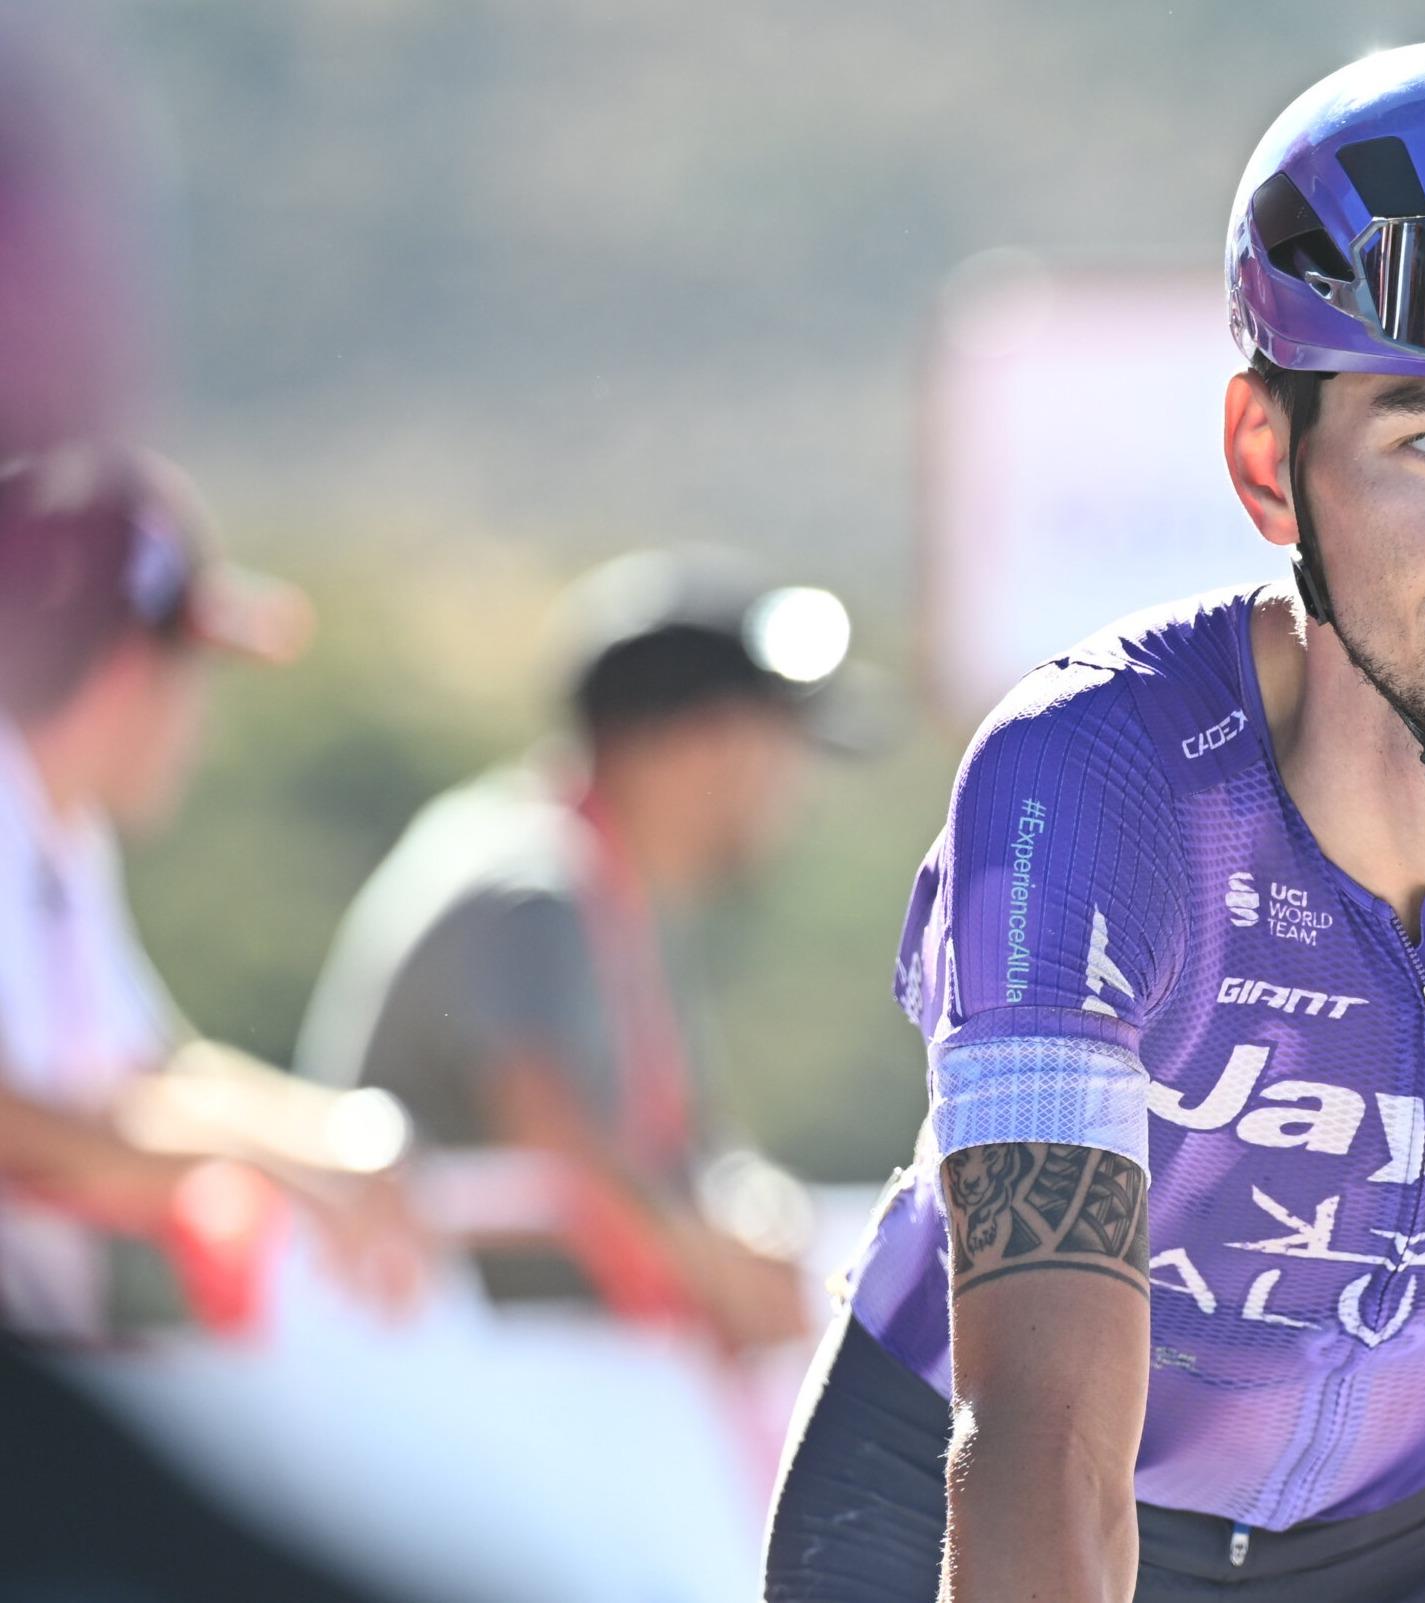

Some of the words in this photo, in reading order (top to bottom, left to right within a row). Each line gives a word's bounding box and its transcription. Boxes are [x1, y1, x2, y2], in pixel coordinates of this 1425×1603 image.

[1182, 708, 1249, 759] CADEX
[1006, 798, 1047, 1003] #ExperienceAlUla
[1271, 882, 1308, 907] UCI
[1267, 918, 1318, 947] TEAM
[1269, 901, 1333, 929] WORLD
[1216, 976, 1370, 1020] GIANT
